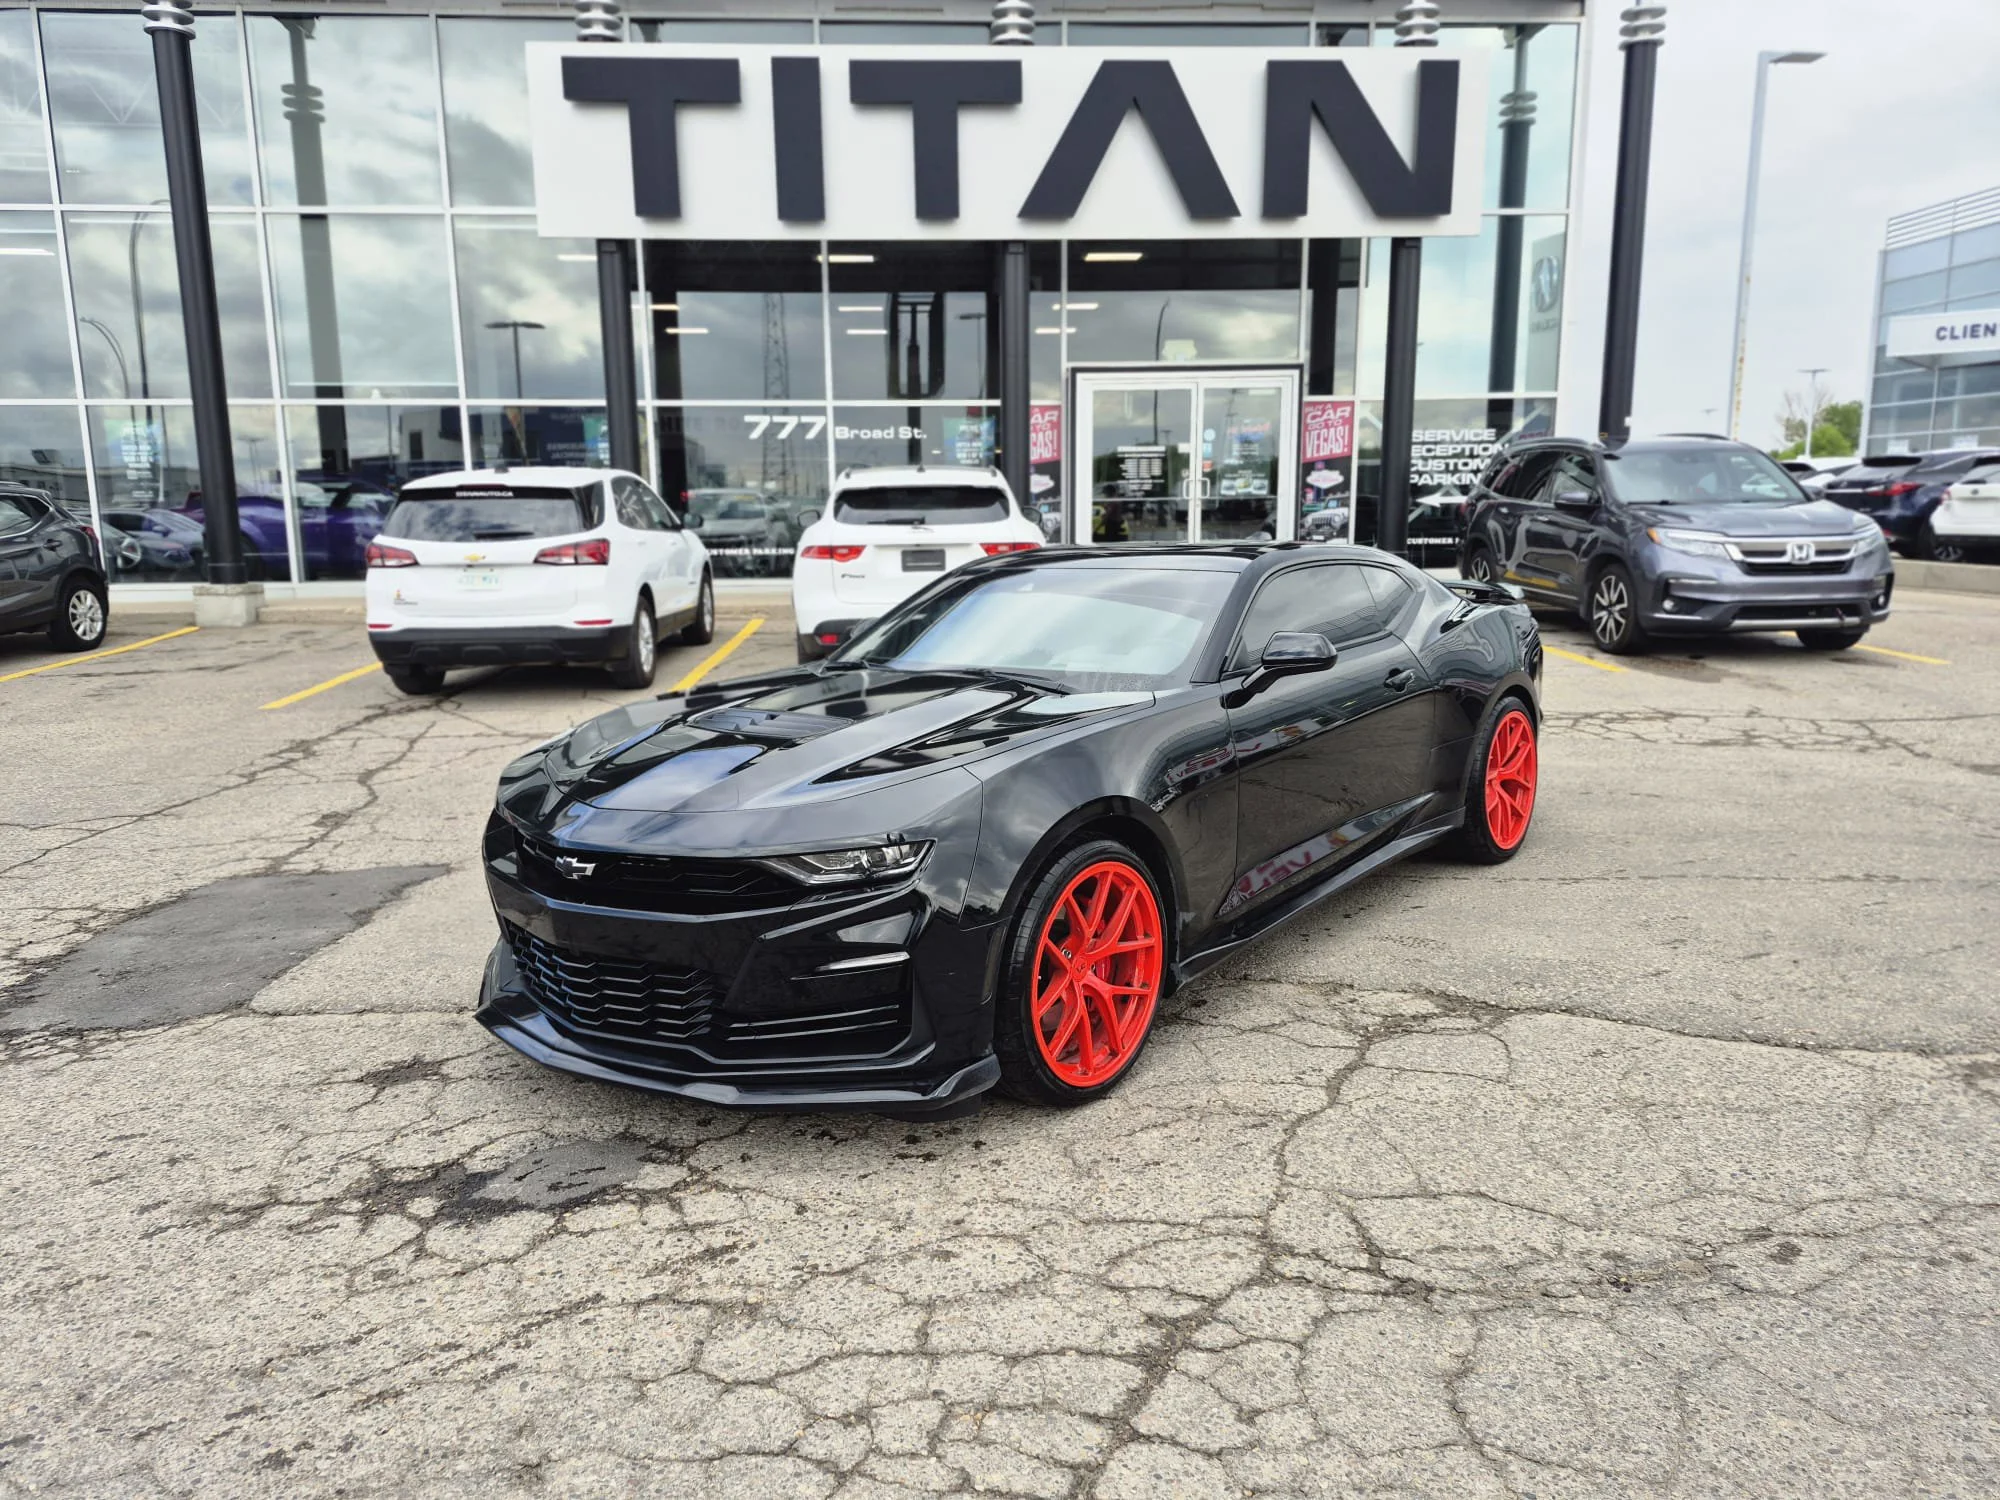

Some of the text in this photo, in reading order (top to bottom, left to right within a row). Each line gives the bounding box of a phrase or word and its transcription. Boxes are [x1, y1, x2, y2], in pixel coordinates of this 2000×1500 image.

[561, 57, 1460, 222] TITAN
[1936, 323, 1999, 341] CLIEN
[1030, 411, 1059, 425] AR
[1306, 406, 1352, 424] CAR
[744, 414, 928, 440] 777 Broad St.
[1412, 428, 1497, 442] SERVICE
[1305, 425, 1349, 459] VEGAS!
[1411, 443, 1510, 457] ECEPTION
